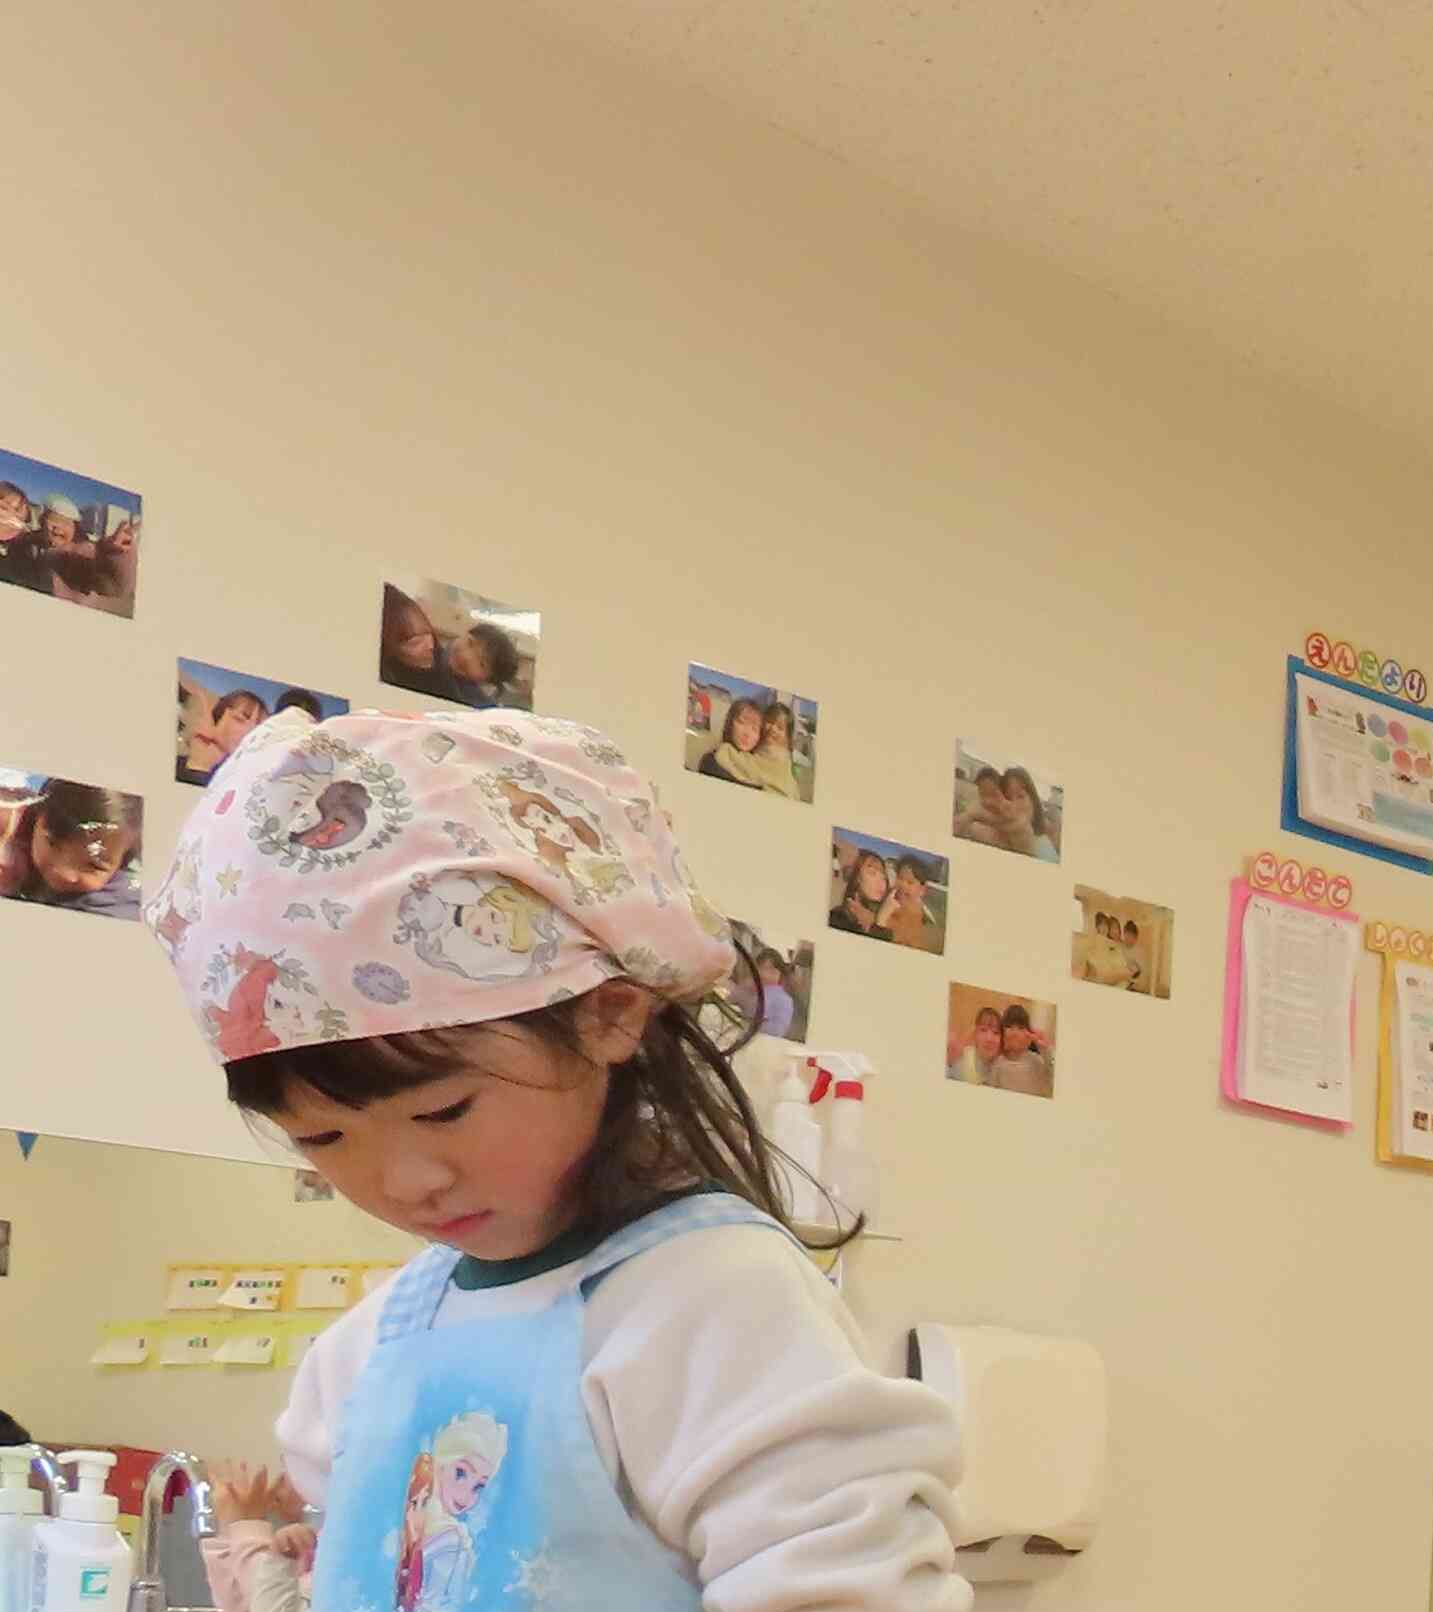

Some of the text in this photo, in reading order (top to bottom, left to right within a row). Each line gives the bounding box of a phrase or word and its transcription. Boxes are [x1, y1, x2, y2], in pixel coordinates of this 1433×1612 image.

[1307, 634, 1426, 703] えんだより
[1255, 853, 1351, 908] こんだて
